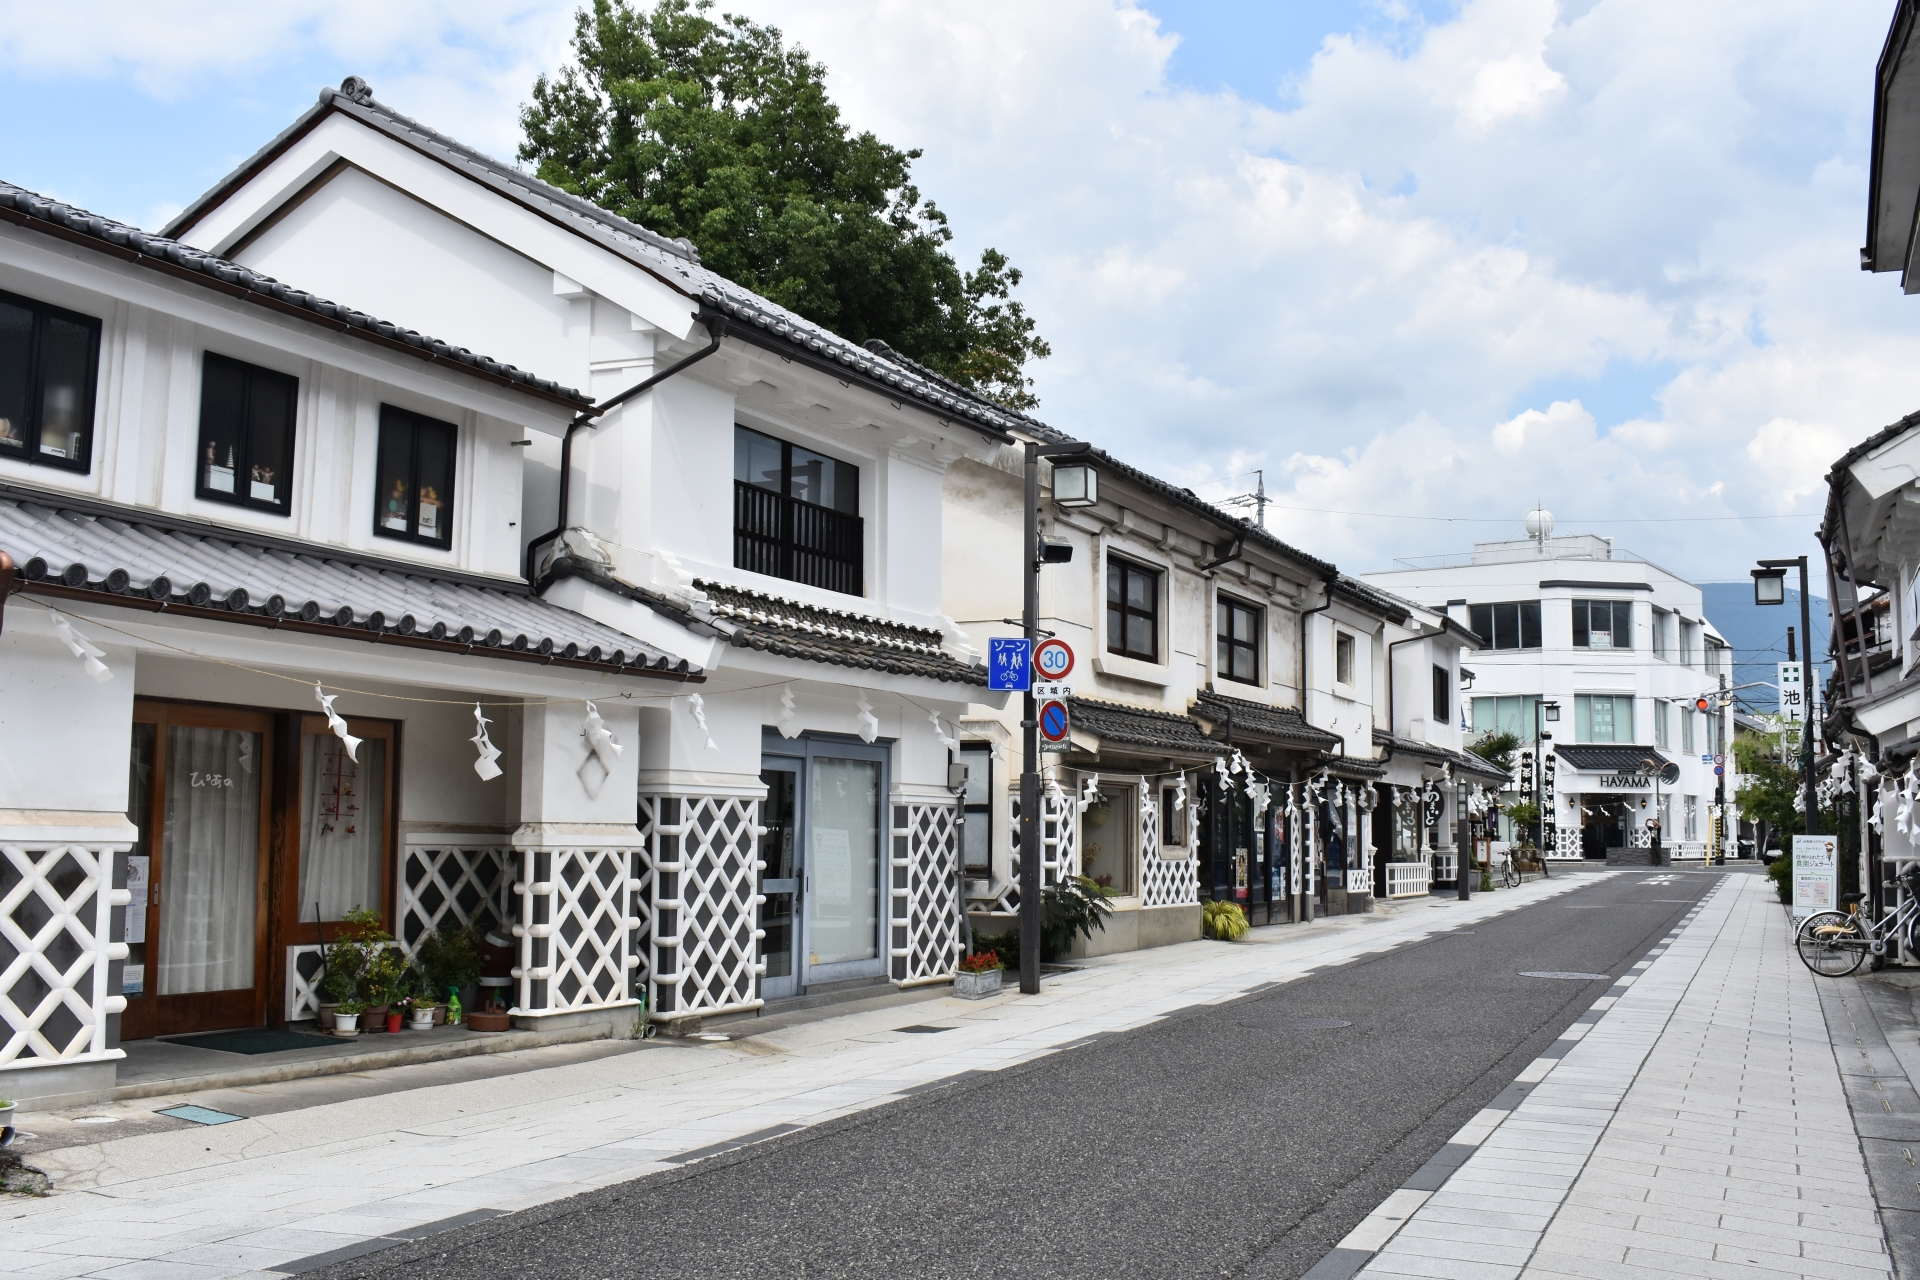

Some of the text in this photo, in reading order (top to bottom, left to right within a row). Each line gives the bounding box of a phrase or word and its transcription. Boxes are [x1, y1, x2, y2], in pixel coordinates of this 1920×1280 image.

[994, 641, 1026, 652] ゾーン
[1043, 650, 1066, 669] 30
[1037, 686, 1071, 695] 区域内
[190, 771, 233, 789] ぴあの
[1600, 776, 1651, 787] HAYAMA
[1796, 860, 1834, 868] 農園ジェラート
